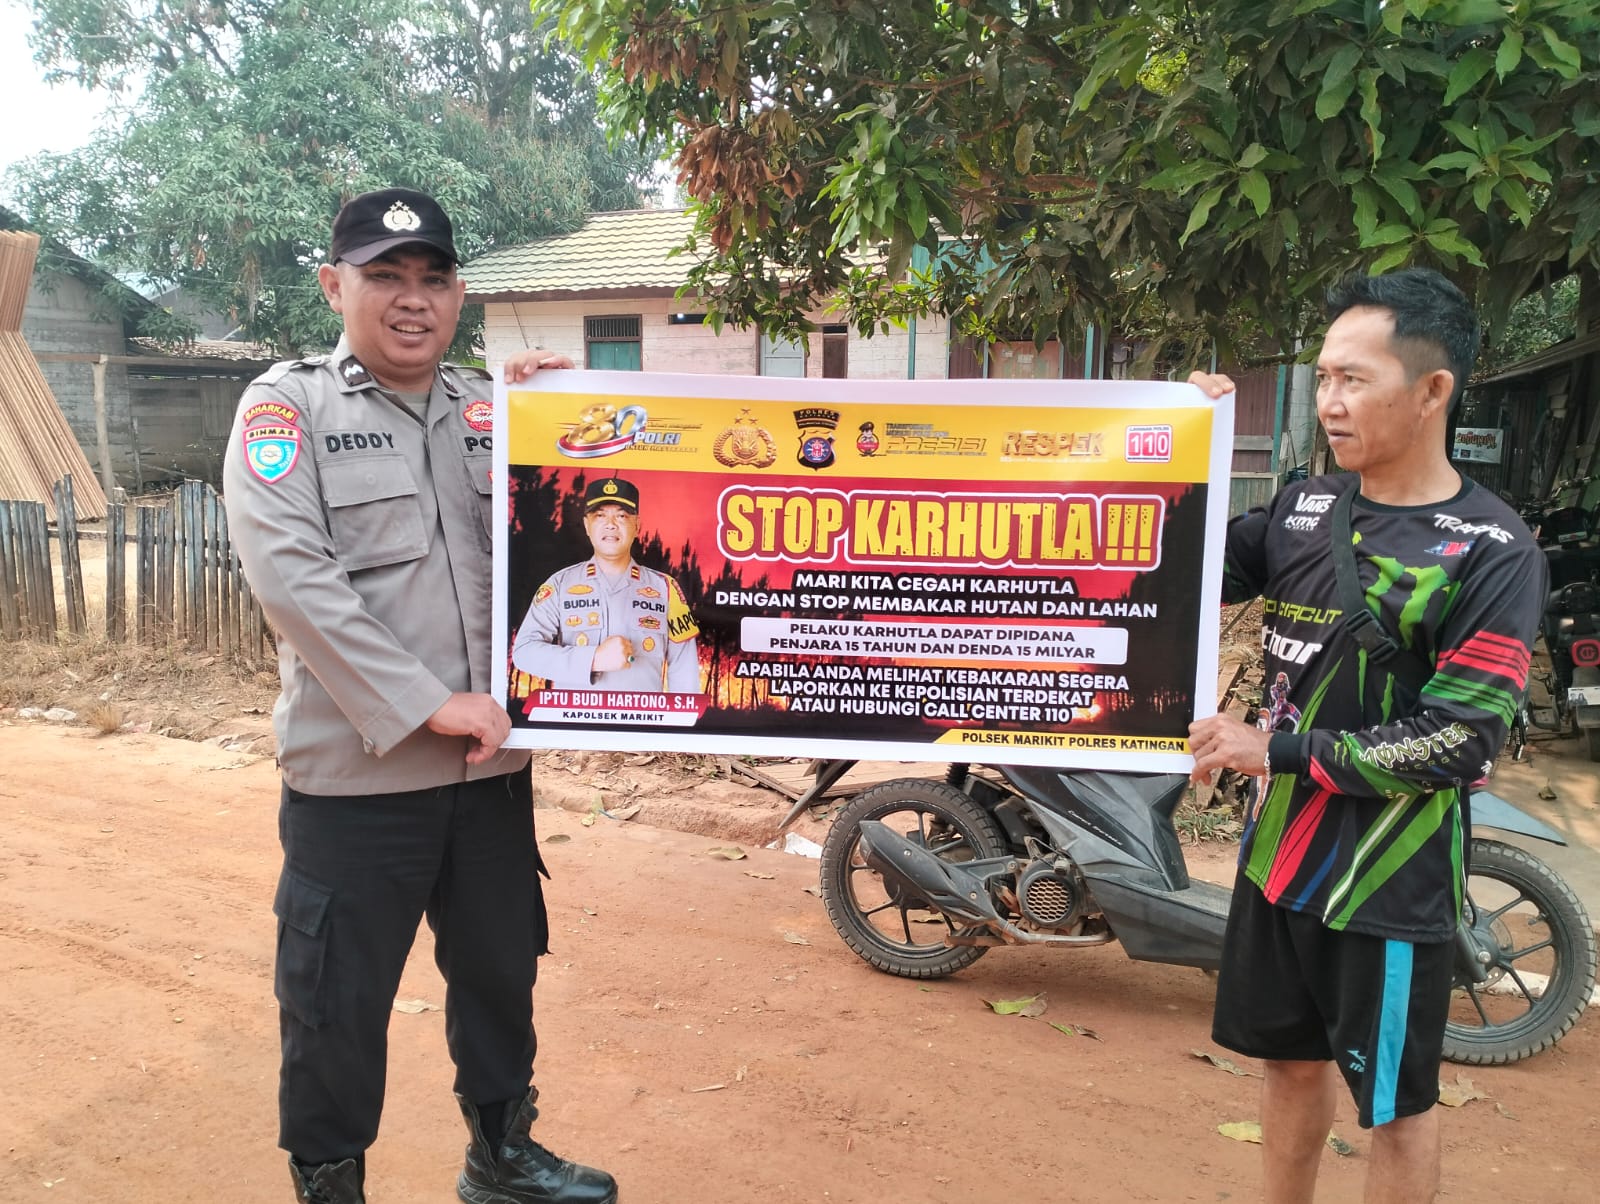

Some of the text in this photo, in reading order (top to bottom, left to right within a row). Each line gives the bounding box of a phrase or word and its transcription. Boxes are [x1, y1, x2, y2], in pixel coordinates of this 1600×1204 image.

[249, 428, 294, 439] BINMAS
[325, 432, 394, 453] DEDDY
[633, 431, 681, 445] POLRI
[887, 436, 987, 452] PRESISI
[1001, 431, 1104, 456] RESPEK
[1130, 434, 1169, 456] 110
[1295, 492, 1337, 513] VANS
[726, 493, 1156, 562] STOP KARHUTLA !!!
[796, 573, 1075, 595] MARI KITA CEGAH KARHUTLA
[632, 600, 665, 613] POLRI
[715, 591, 1158, 618] DENGAN STOP MEMBAKAR HUTAN DAN LAHAN
[790, 623, 1075, 642] PELAKU KARHUTLA DAPAT DIPIDANA
[770, 638, 1095, 659] PENJARA 15 TAHUN DAN DENDA 15 MILYAR
[737, 662, 1129, 690] APABILA ANDA MELIHAT KEBAKARAN SEGERA
[539, 691, 699, 711] IPTU BUDI HARTONO, S.H.
[771, 680, 1093, 707] LAPORKAN KE KEPOLISIAN TERDEKAT
[562, 711, 665, 722] KAPOLSEK MARIKIT
[791, 698, 1071, 723] ATAU HUBUNGI CALL CENTER 110
[962, 732, 1185, 751] POLSEK MARIKIT POLRES KATINGAN
